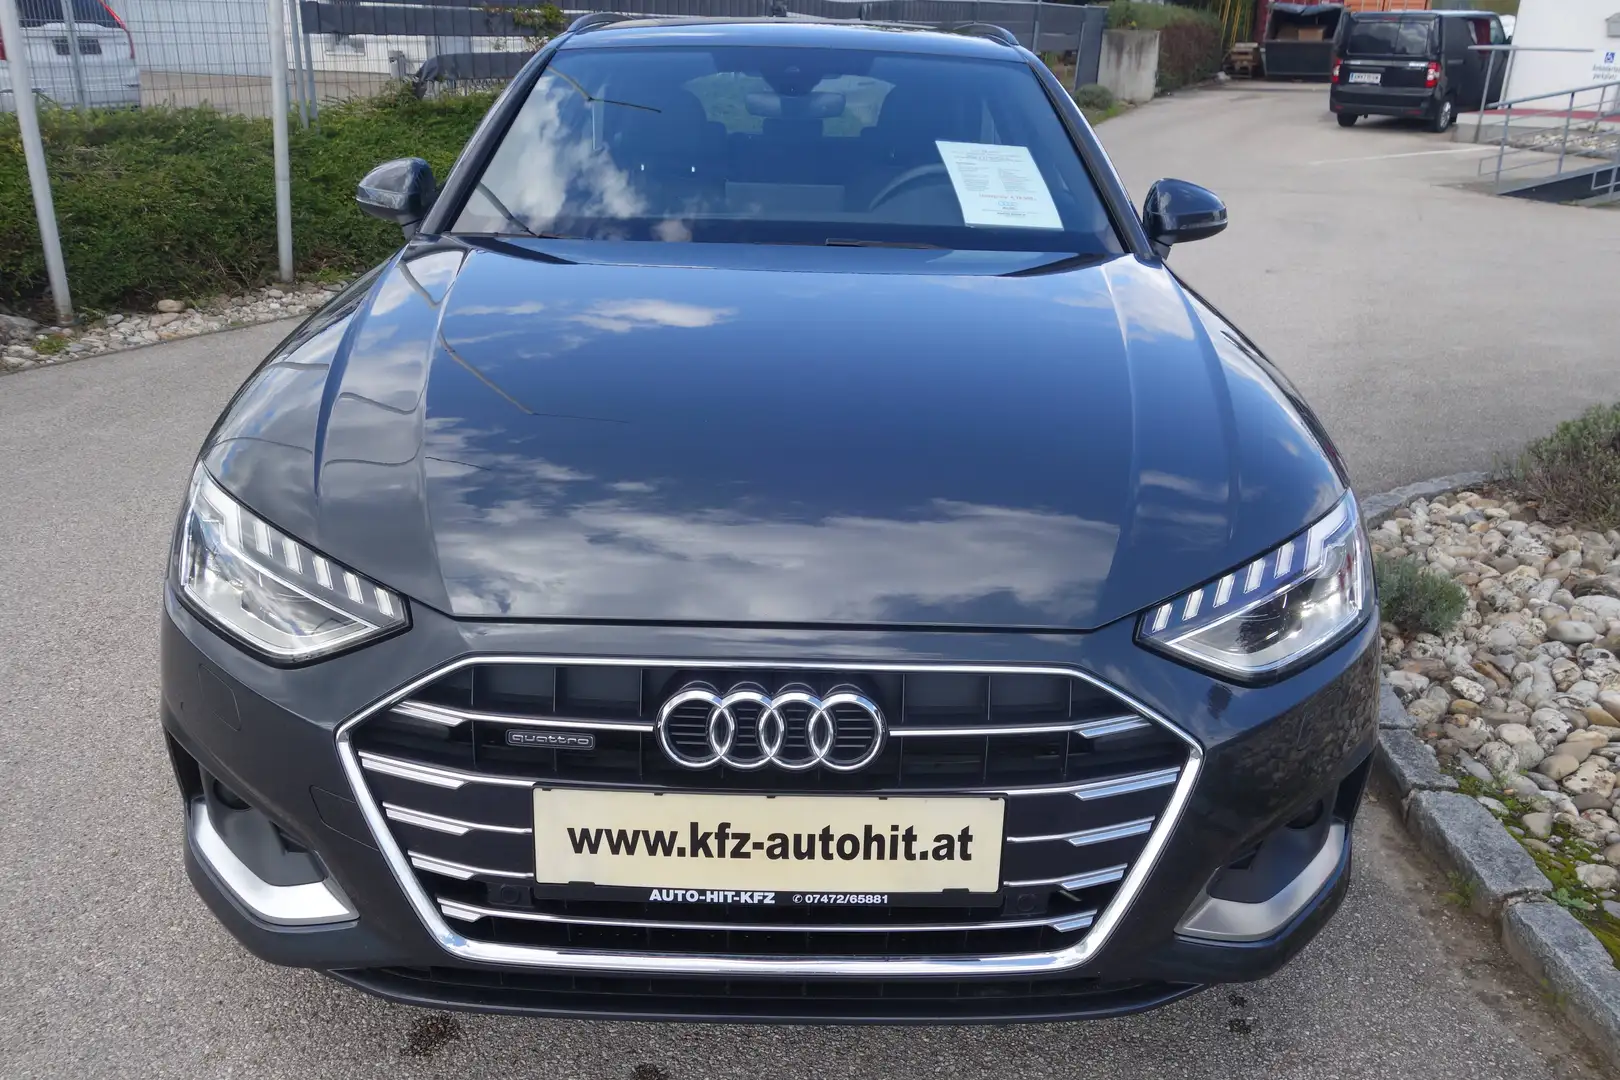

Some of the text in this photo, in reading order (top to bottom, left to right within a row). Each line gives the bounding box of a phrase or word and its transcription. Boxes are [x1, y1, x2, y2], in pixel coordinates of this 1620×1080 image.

[512, 734, 589, 745] quattro
[567, 821, 974, 861] www.kfz-autohit.at
[649, 889, 775, 904] AUTO-HIT-KFZ
[805, 894, 889, 904] 07472/65881
